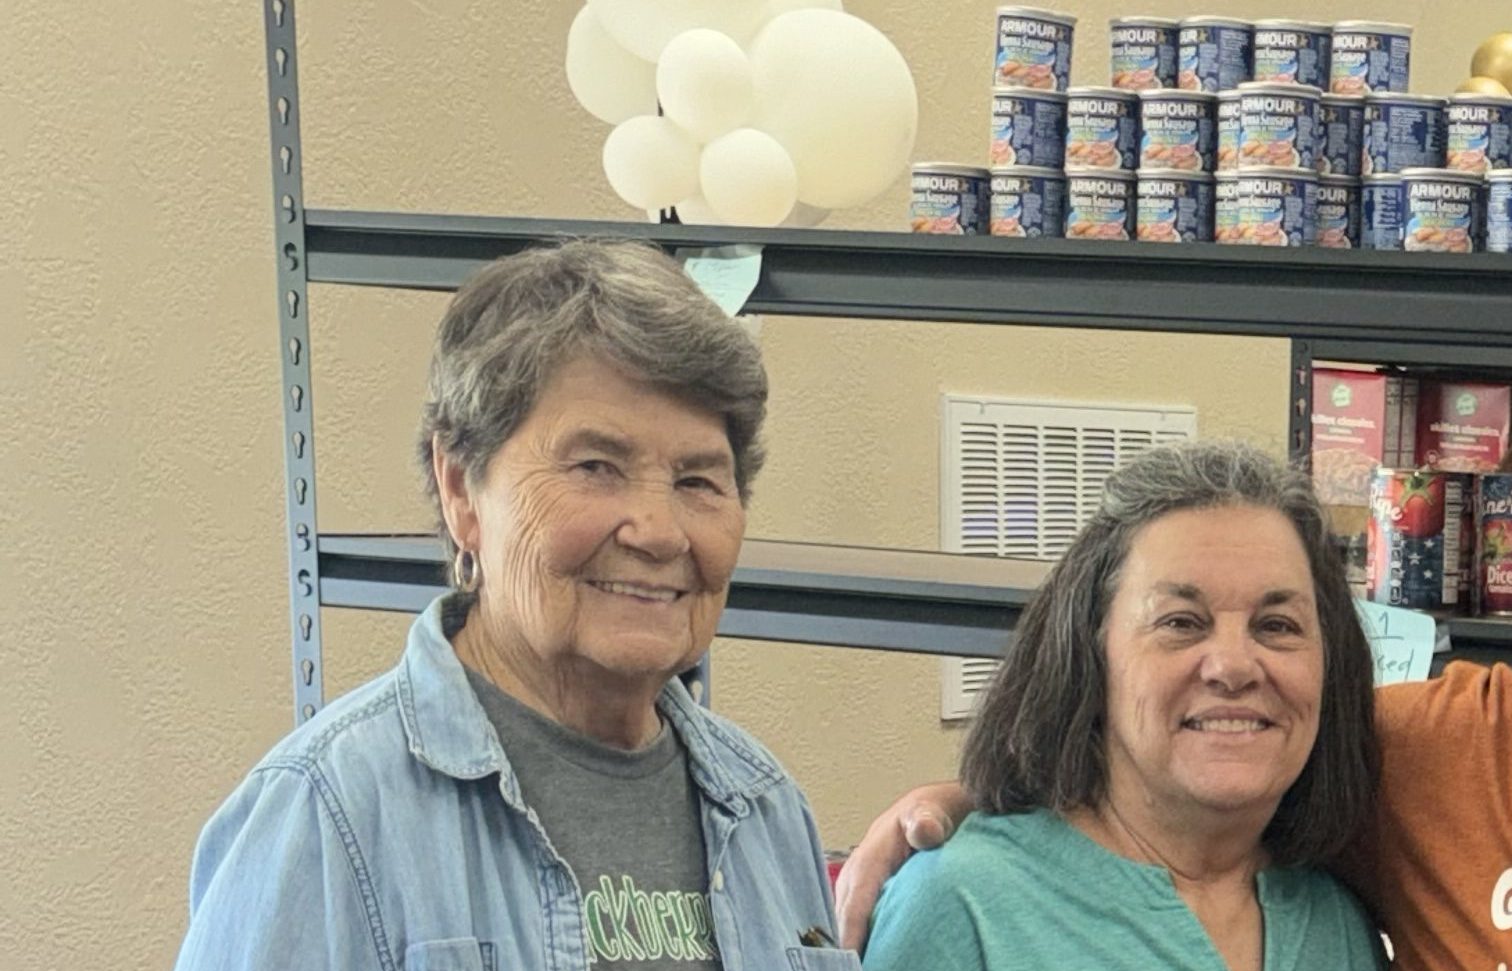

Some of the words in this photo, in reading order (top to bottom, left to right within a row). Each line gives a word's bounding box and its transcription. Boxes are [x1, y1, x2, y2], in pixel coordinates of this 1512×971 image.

[1001, 19, 1056, 38] ARMOUR
[1142, 102, 1197, 116] ARMOUR
[1241, 98, 1296, 113] ARMOUR
[1410, 184, 1470, 200] ARMOUR
